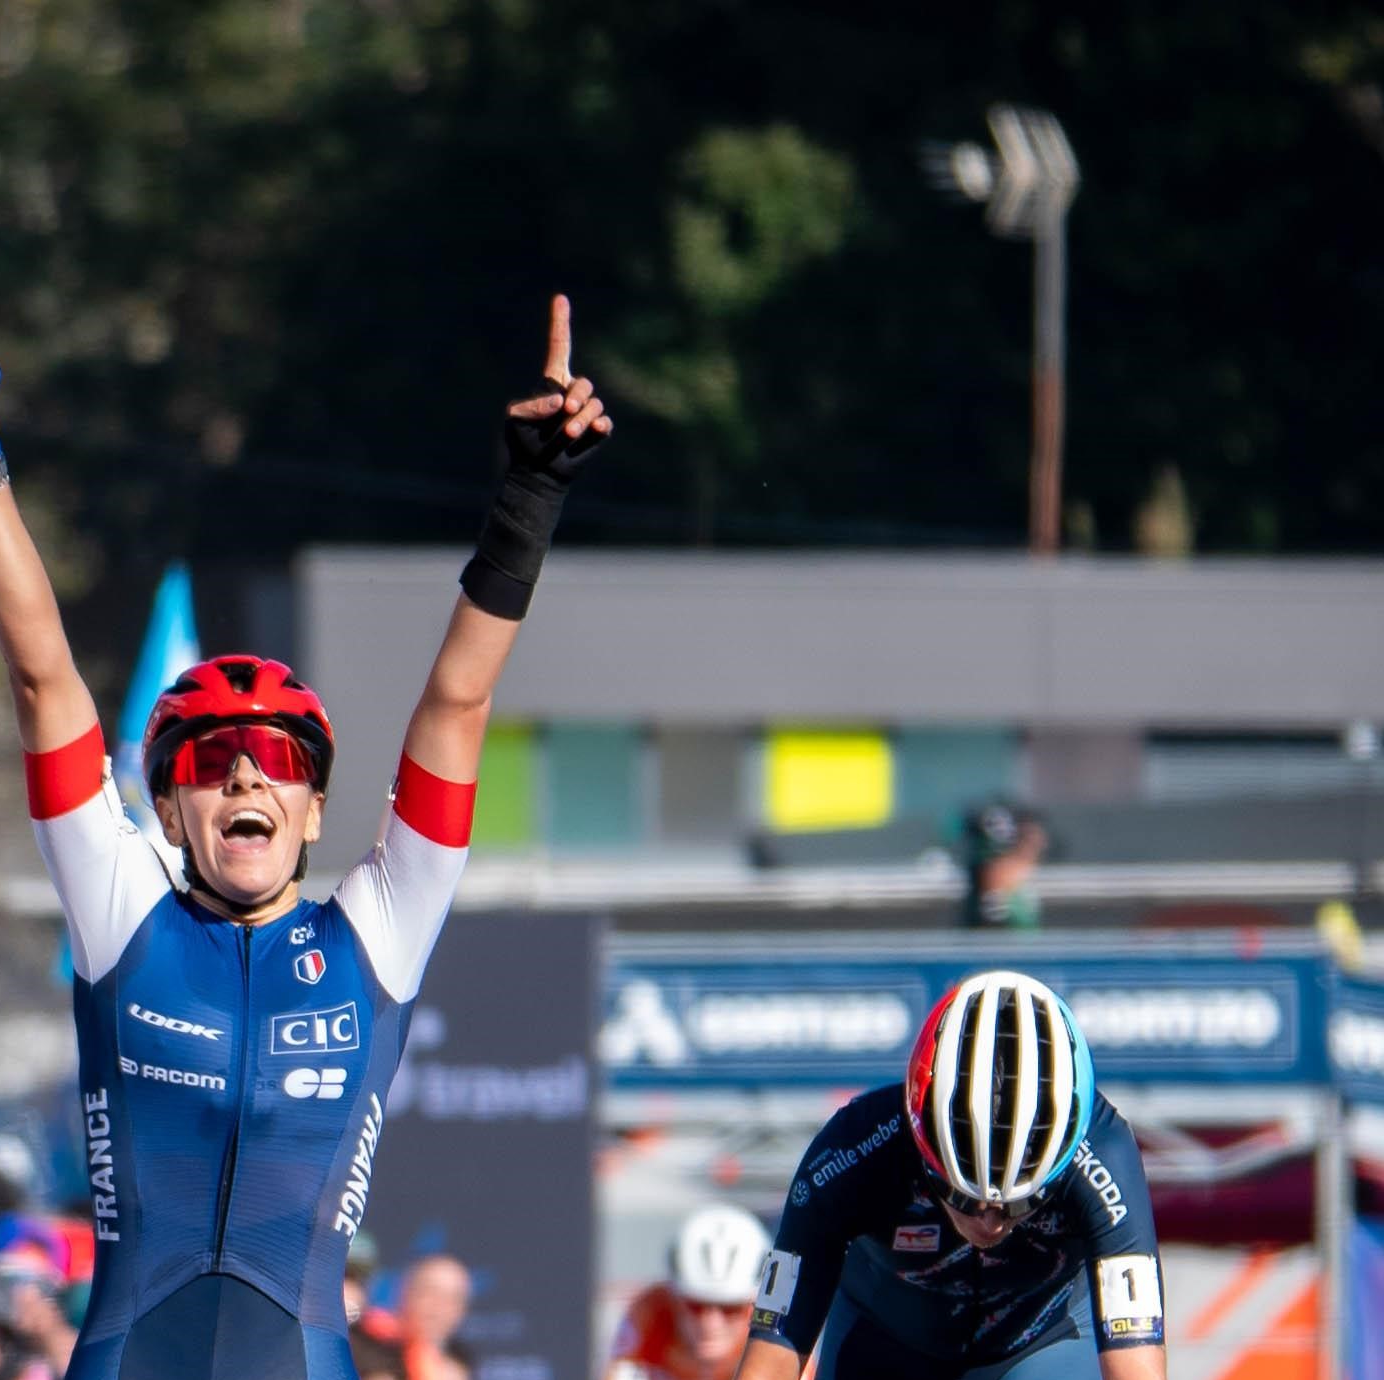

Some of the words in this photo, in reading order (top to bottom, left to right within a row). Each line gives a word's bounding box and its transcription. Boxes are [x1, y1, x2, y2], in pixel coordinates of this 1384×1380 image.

[129, 1003, 225, 1041] LOOK
[281, 1013, 353, 1046] CIC
[142, 1064, 226, 1091] FACOM
[85, 1087, 120, 1242] FRANCE
[812, 1148, 859, 1188] emile
[857, 1114, 902, 1158] webe
[334, 1092, 384, 1248] FRANCE
[765, 1260, 779, 1296] 1
[1121, 1267, 1137, 1302] 1
[753, 1310, 775, 1325] LE
